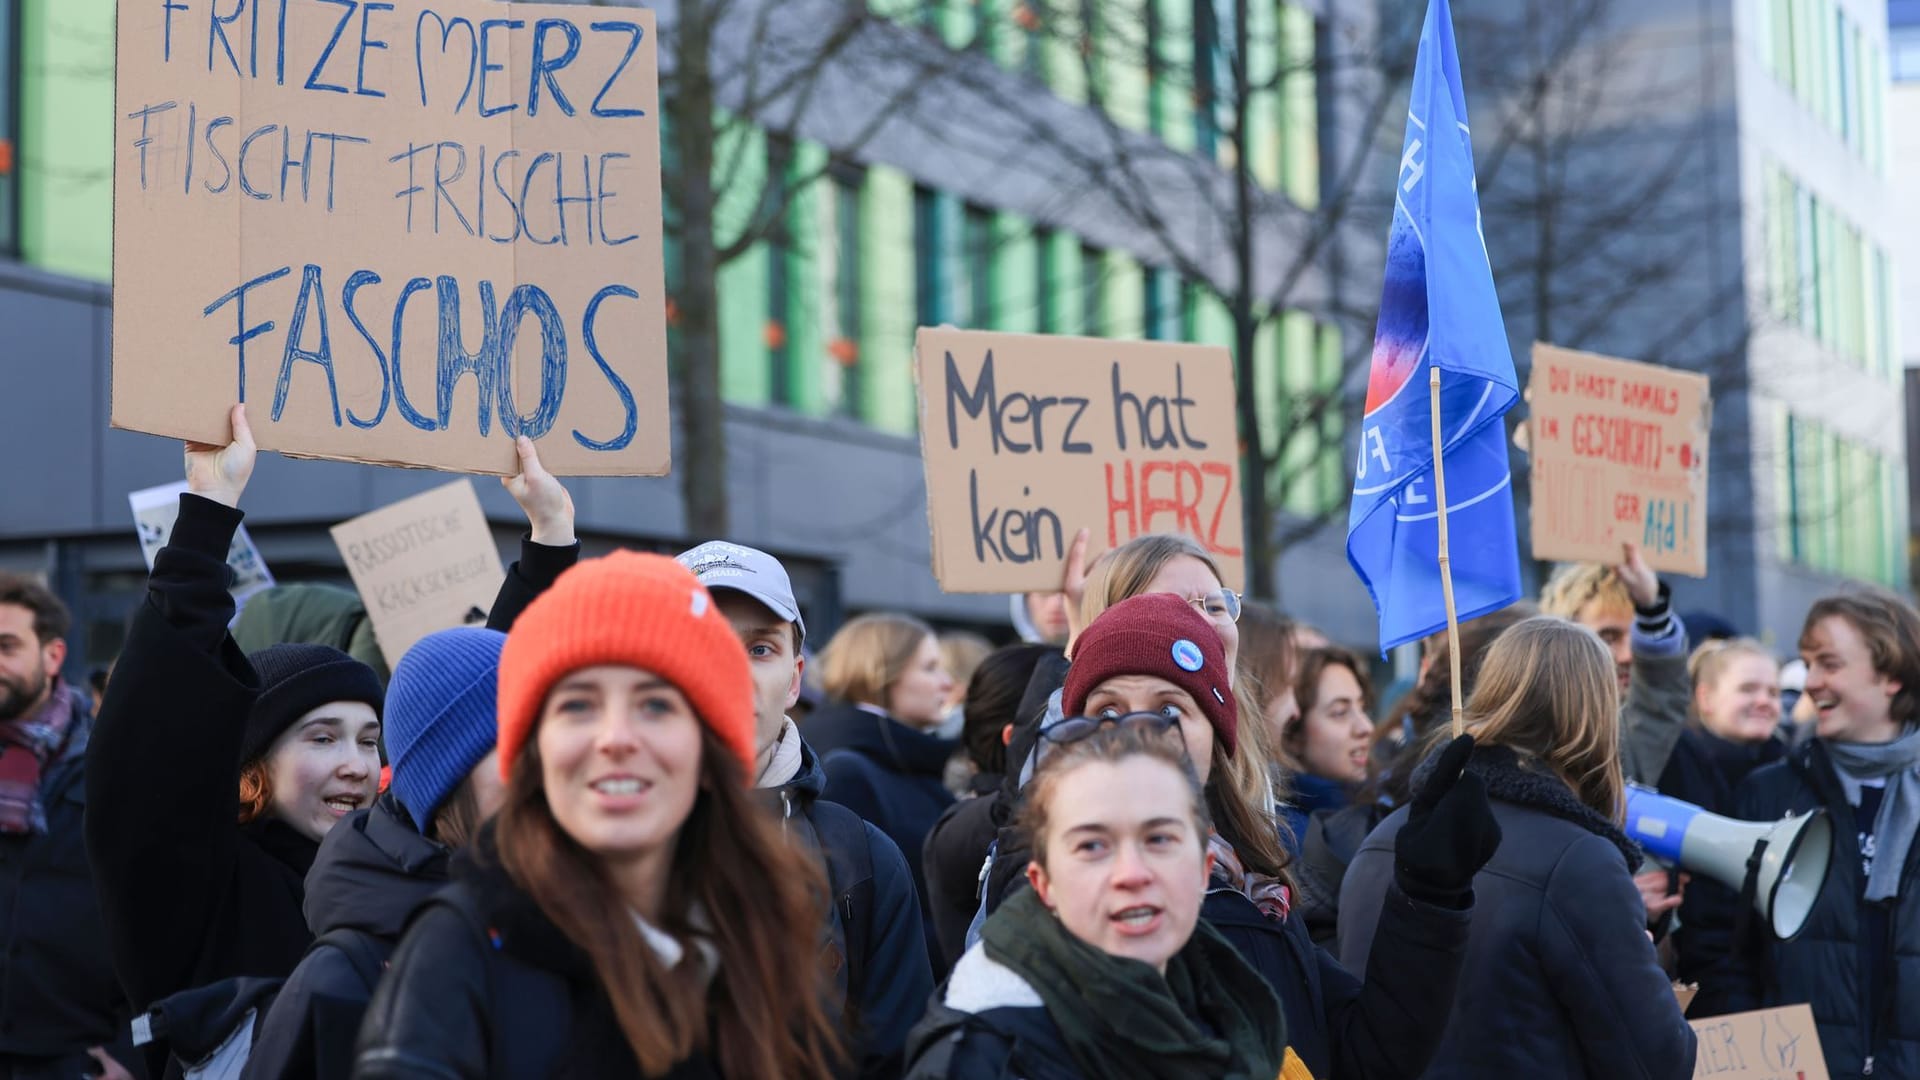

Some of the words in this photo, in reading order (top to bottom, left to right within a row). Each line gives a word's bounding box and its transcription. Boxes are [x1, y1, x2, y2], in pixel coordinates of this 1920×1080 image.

[416, 9, 646, 119] MERZ
[128, 100, 371, 213] FISCHT
[388, 140, 640, 248] FRISCHE
[203, 263, 640, 452] FASCHOS
[944, 349, 1094, 455] Merz
[1111, 361, 1208, 451] hat
[1548, 364, 1571, 394] DU
[1575, 371, 1617, 400] HAST
[1622, 380, 1680, 416] DAMALS
[347, 506, 464, 578] RASSISTISCHE
[969, 467, 1064, 564] kein
[1104, 459, 1242, 558] HERZ
